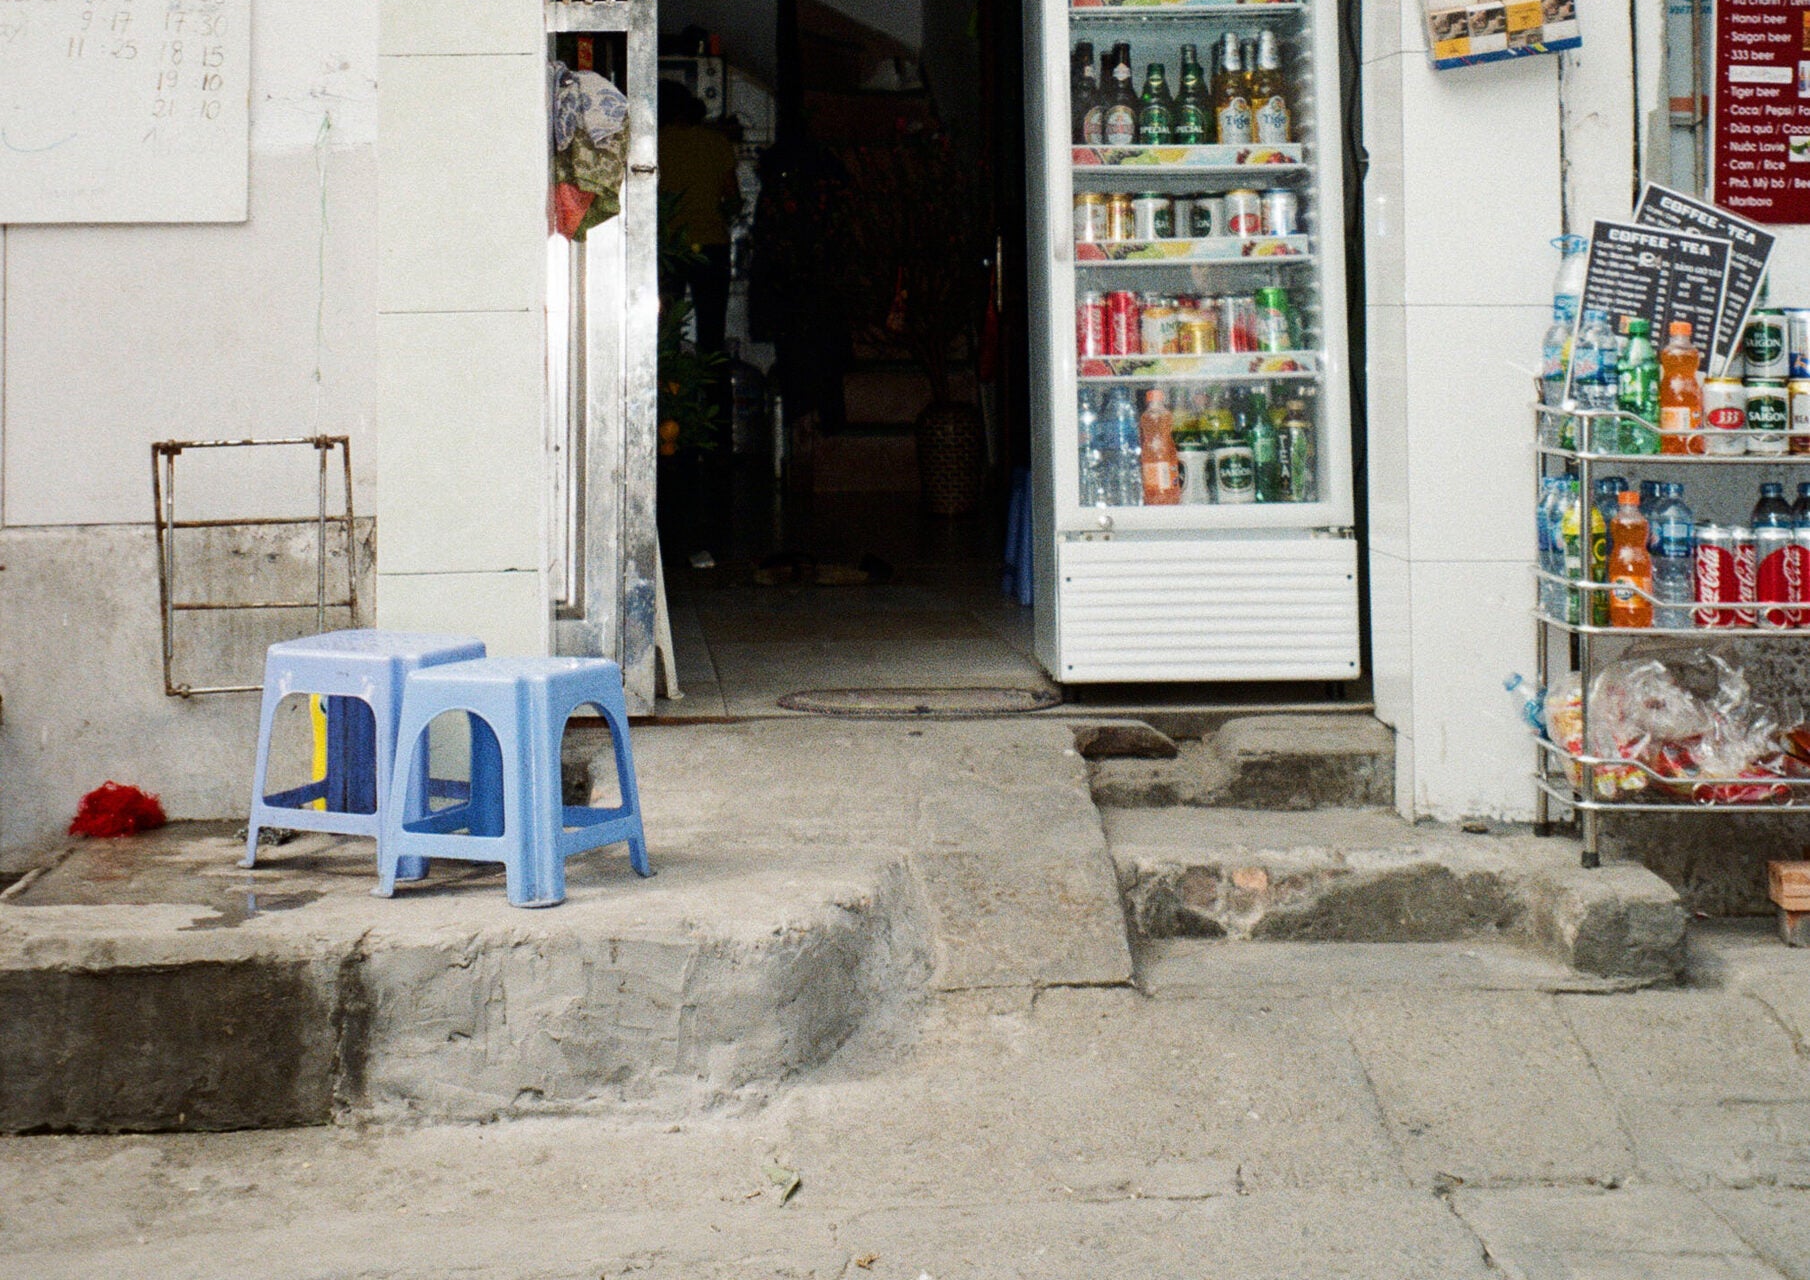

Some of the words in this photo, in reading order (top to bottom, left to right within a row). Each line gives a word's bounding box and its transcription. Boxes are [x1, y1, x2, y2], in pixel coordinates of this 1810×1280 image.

[1731, 13, 1761, 24] Hanoi
[1763, 13, 1787, 24] beer
[1731, 31, 1766, 45] Saigon
[1768, 32, 1792, 43] beer
[1730, 49, 1749, 61] 333
[1751, 50, 1775, 61] beer
[1730, 85, 1754, 99] Tiger
[1756, 87, 1781, 98] beer
[1759, 141, 1786, 152] Lavie
[1763, 160, 1787, 171] Rice
[1728, 195, 1773, 207] Marlboro
[1660, 196, 1719, 228] COFFEE
[1727, 224, 1757, 245] TEA
[1609, 229, 1670, 249] COFFEE
[1680, 240, 1711, 256] TEA
